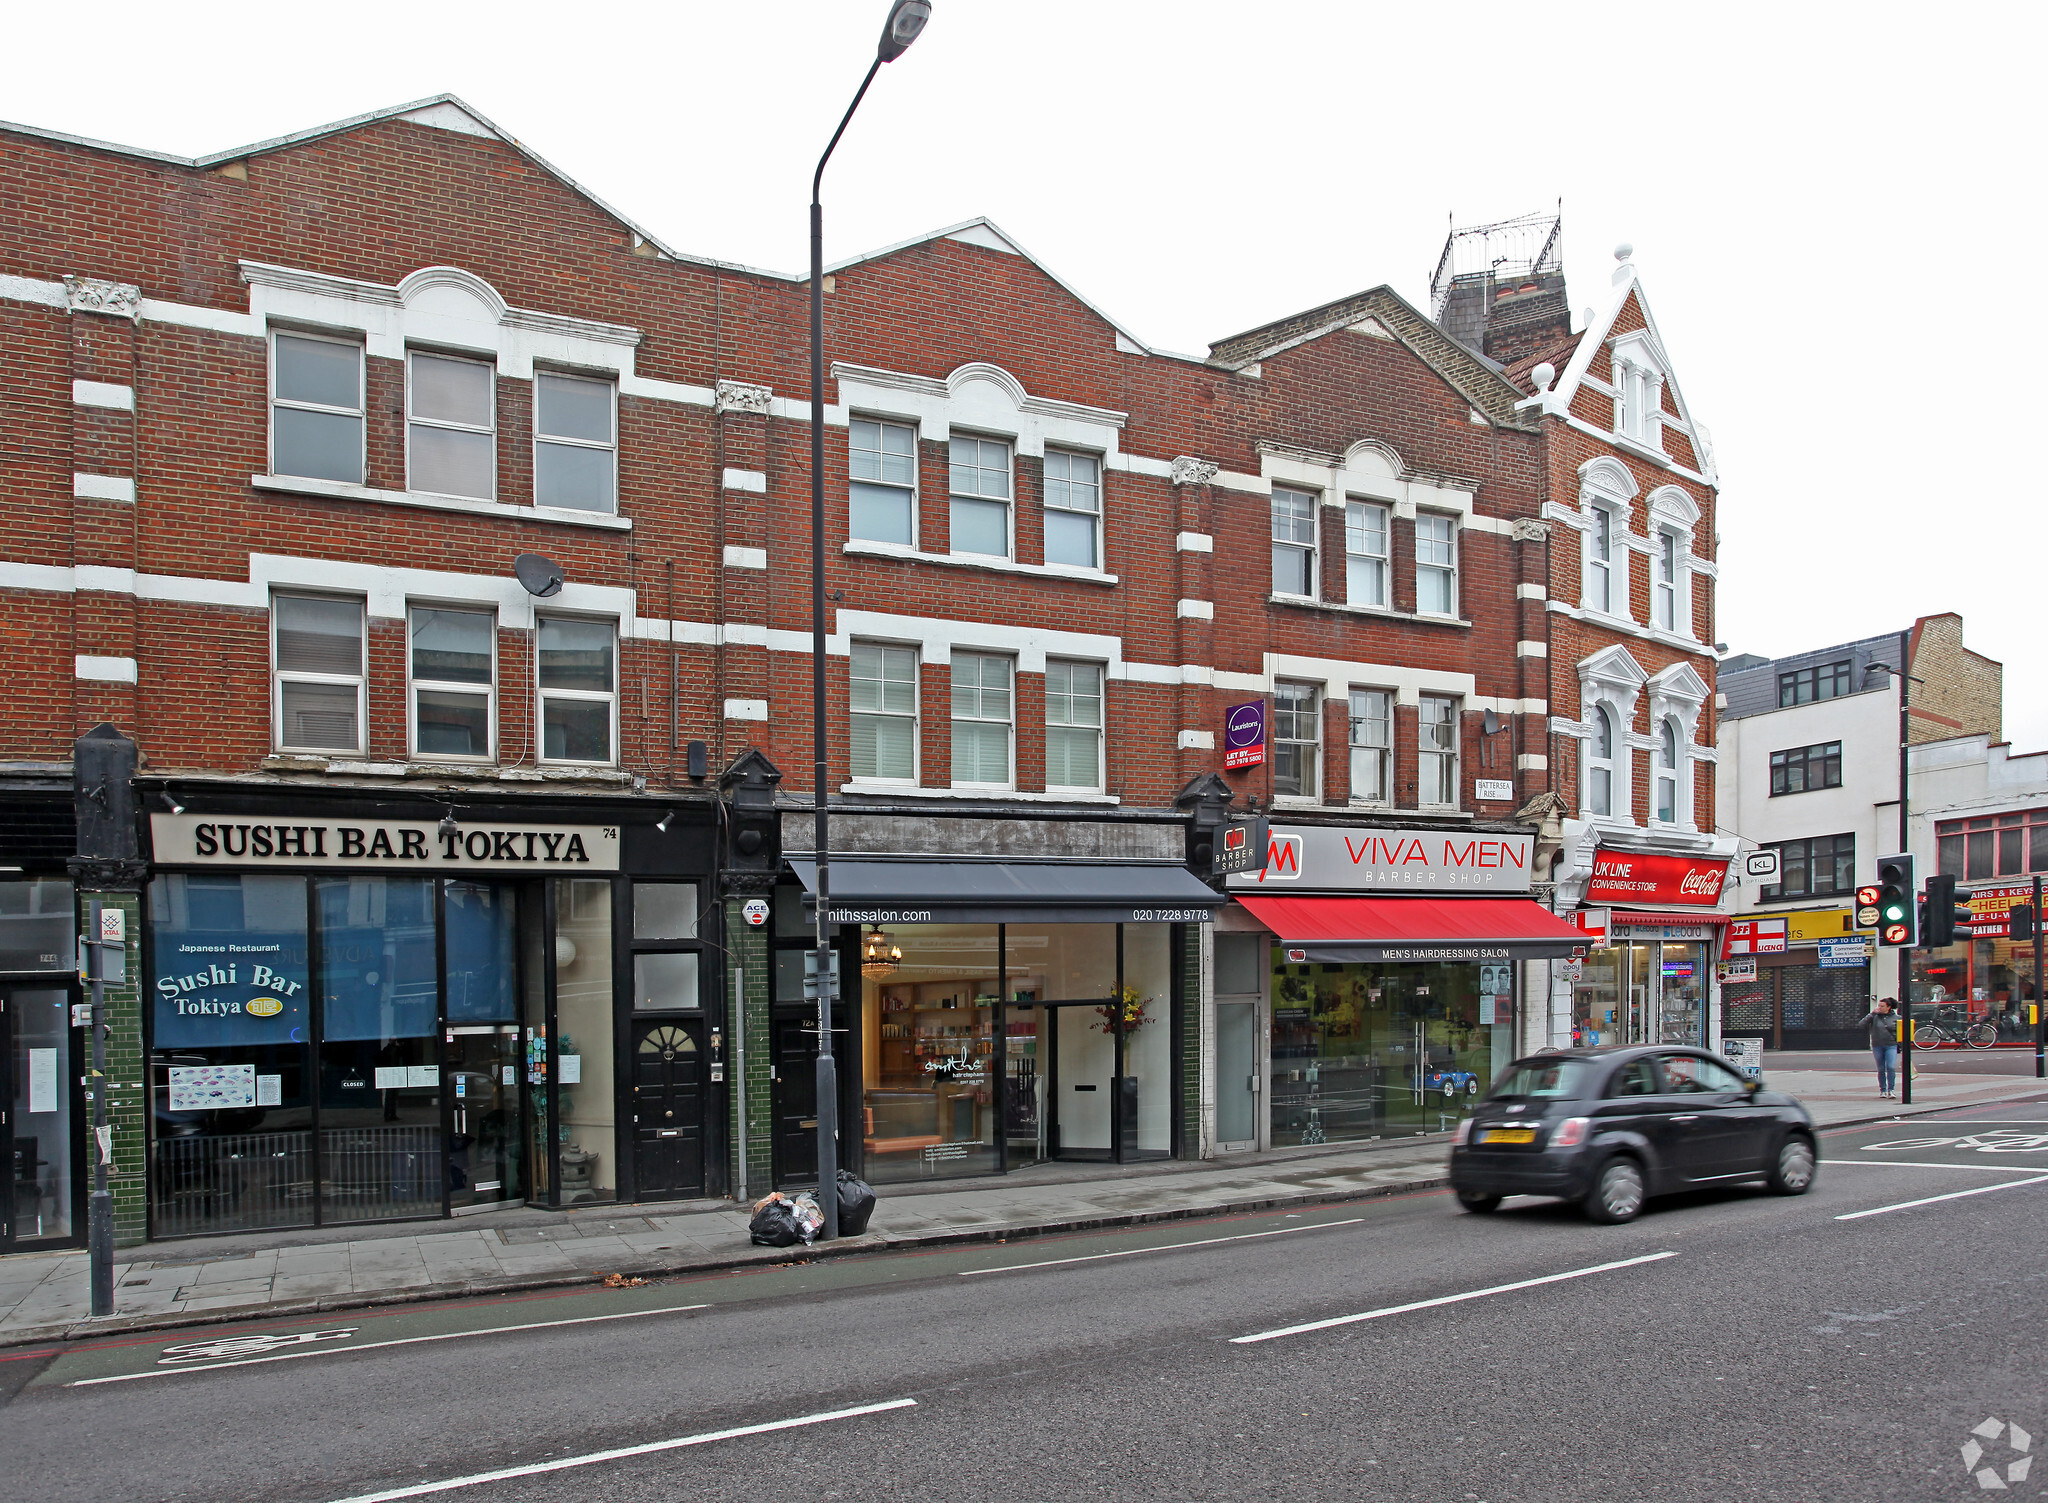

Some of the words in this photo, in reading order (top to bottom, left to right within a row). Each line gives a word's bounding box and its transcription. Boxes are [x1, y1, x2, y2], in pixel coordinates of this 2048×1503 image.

[1231, 720, 1258, 732] Lauristons
[1226, 752, 1238, 760] LET
[1478, 781, 1511, 790] BATTERSEA
[1483, 790, 1496, 798] RISE
[602, 827, 617, 839] 74
[195, 823, 328, 858] SUSHI
[337, 827, 429, 860] BAR
[438, 830, 590, 862] TOKIYA
[1215, 848, 1254, 863] BARBER
[1344, 836, 1429, 866] VIVA
[1443, 840, 1525, 869] MEN
[1221, 859, 1247, 870] SHOP
[1594, 861, 1611, 876] UK
[1609, 862, 1633, 878] LINE
[1754, 860, 1770, 869] KL
[1365, 871, 1436, 883] BARBER
[1448, 873, 1493, 884] SHOP
[1591, 879, 1637, 891] CONVENIENCE
[1636, 881, 1658, 892] STORE
[2009, 886, 2034, 896] KEYS
[1132, 909, 1153, 921] 020
[1155, 909, 1181, 921] 7228
[1183, 909, 1209, 921] 9778
[1670, 925, 1701, 937] Lebara
[178, 944, 226, 954] Japanese
[229, 943, 280, 953] Restaurant
[1382, 949, 1411, 959] MEN'S
[1412, 949, 1479, 959] HAIRDRESSING
[1480, 948, 1509, 958] SALON
[1758, 944, 1784, 952] LICENCE
[157, 962, 238, 1000] Sushi
[250, 964, 302, 997] Bar
[174, 998, 242, 1017] Tokiya
[924, 1045, 982, 1072] smiths
